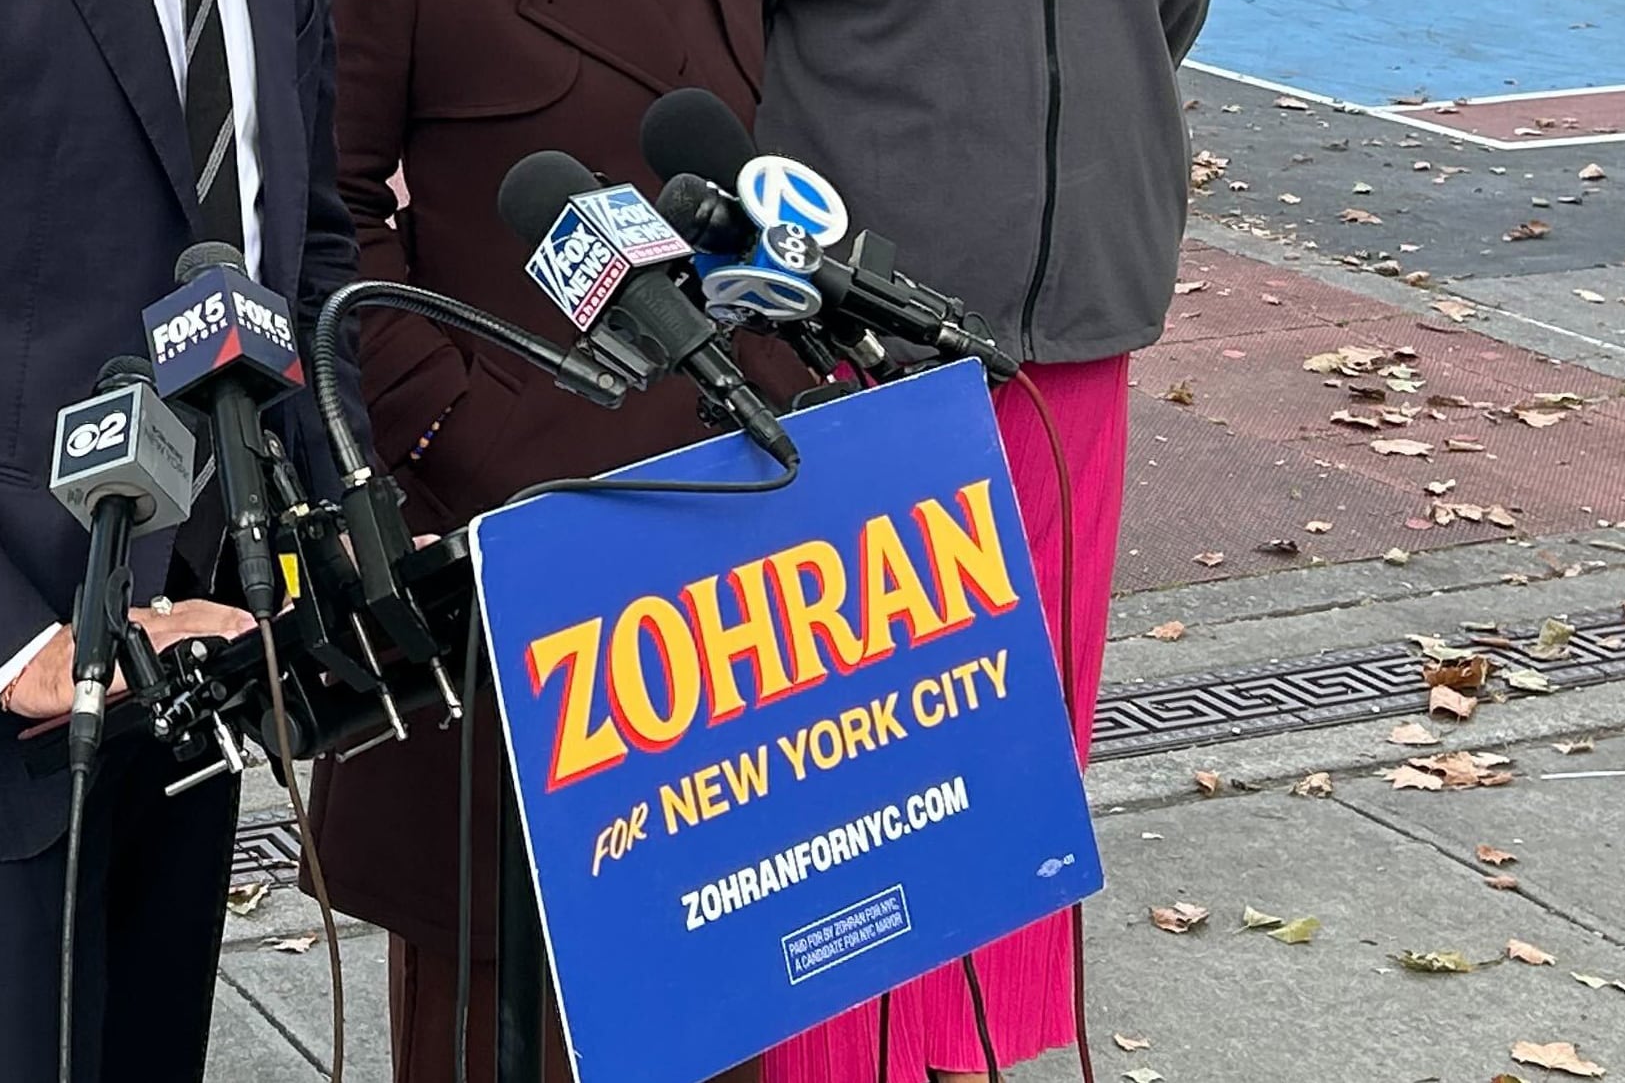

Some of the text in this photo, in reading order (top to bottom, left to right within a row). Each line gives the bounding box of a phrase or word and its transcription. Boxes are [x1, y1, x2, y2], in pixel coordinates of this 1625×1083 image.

[612, 203, 658, 229] FOX
[617, 222, 673, 246] NEWS
[778, 223, 807, 268] abc
[555, 222, 599, 277] FOX
[566, 241, 612, 305] NEWS
[577, 259, 625, 326] channel
[157, 317, 228, 364] NEW YORK
[526, 479, 1020, 793] ZOHRAN
[592, 650, 1009, 876] FOR NEW YORK CITY
[680, 776, 970, 932] ZOHRANFORNYC.COM
